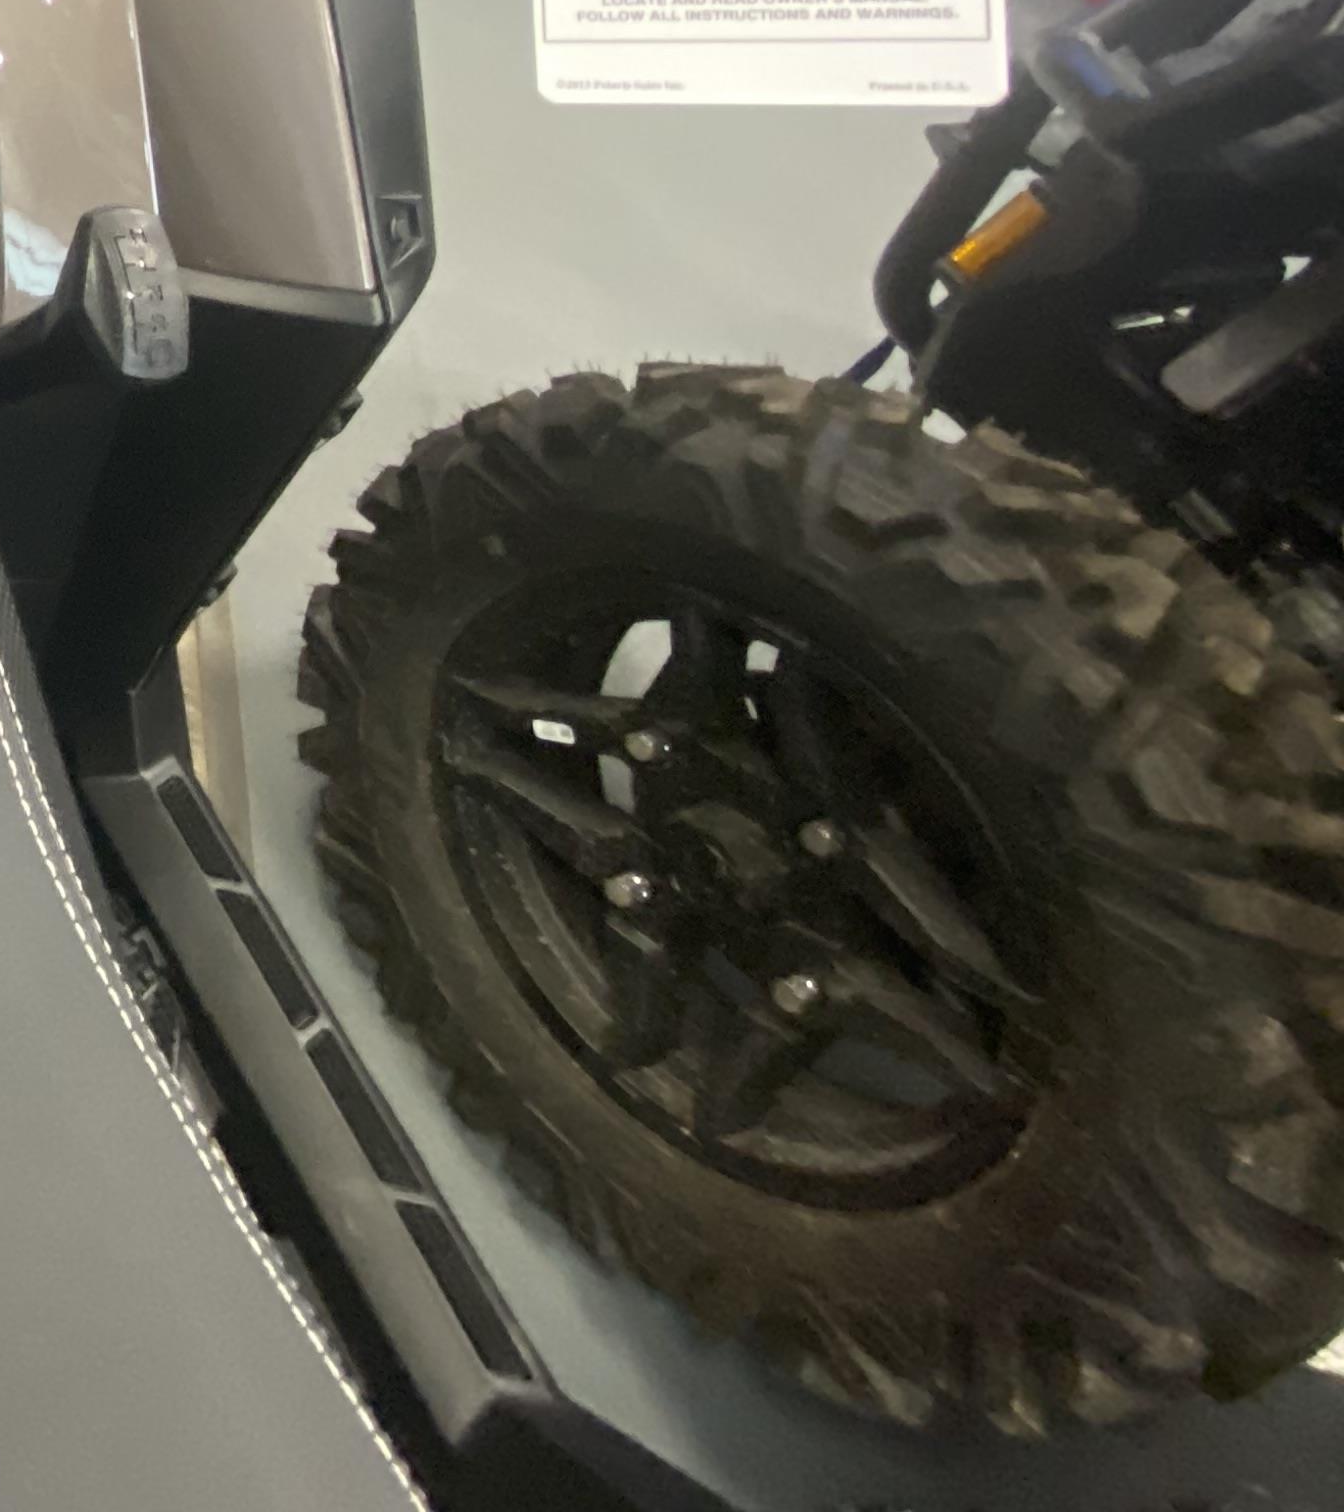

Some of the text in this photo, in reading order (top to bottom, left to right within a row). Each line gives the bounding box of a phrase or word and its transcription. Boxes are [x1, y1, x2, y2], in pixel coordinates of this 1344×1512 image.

[576, 10, 645, 23] FOLLOW
[649, 9, 682, 22] ALL
[685, 8, 811, 22] INSTRUCTIONS
[815, 7, 852, 20] AND
